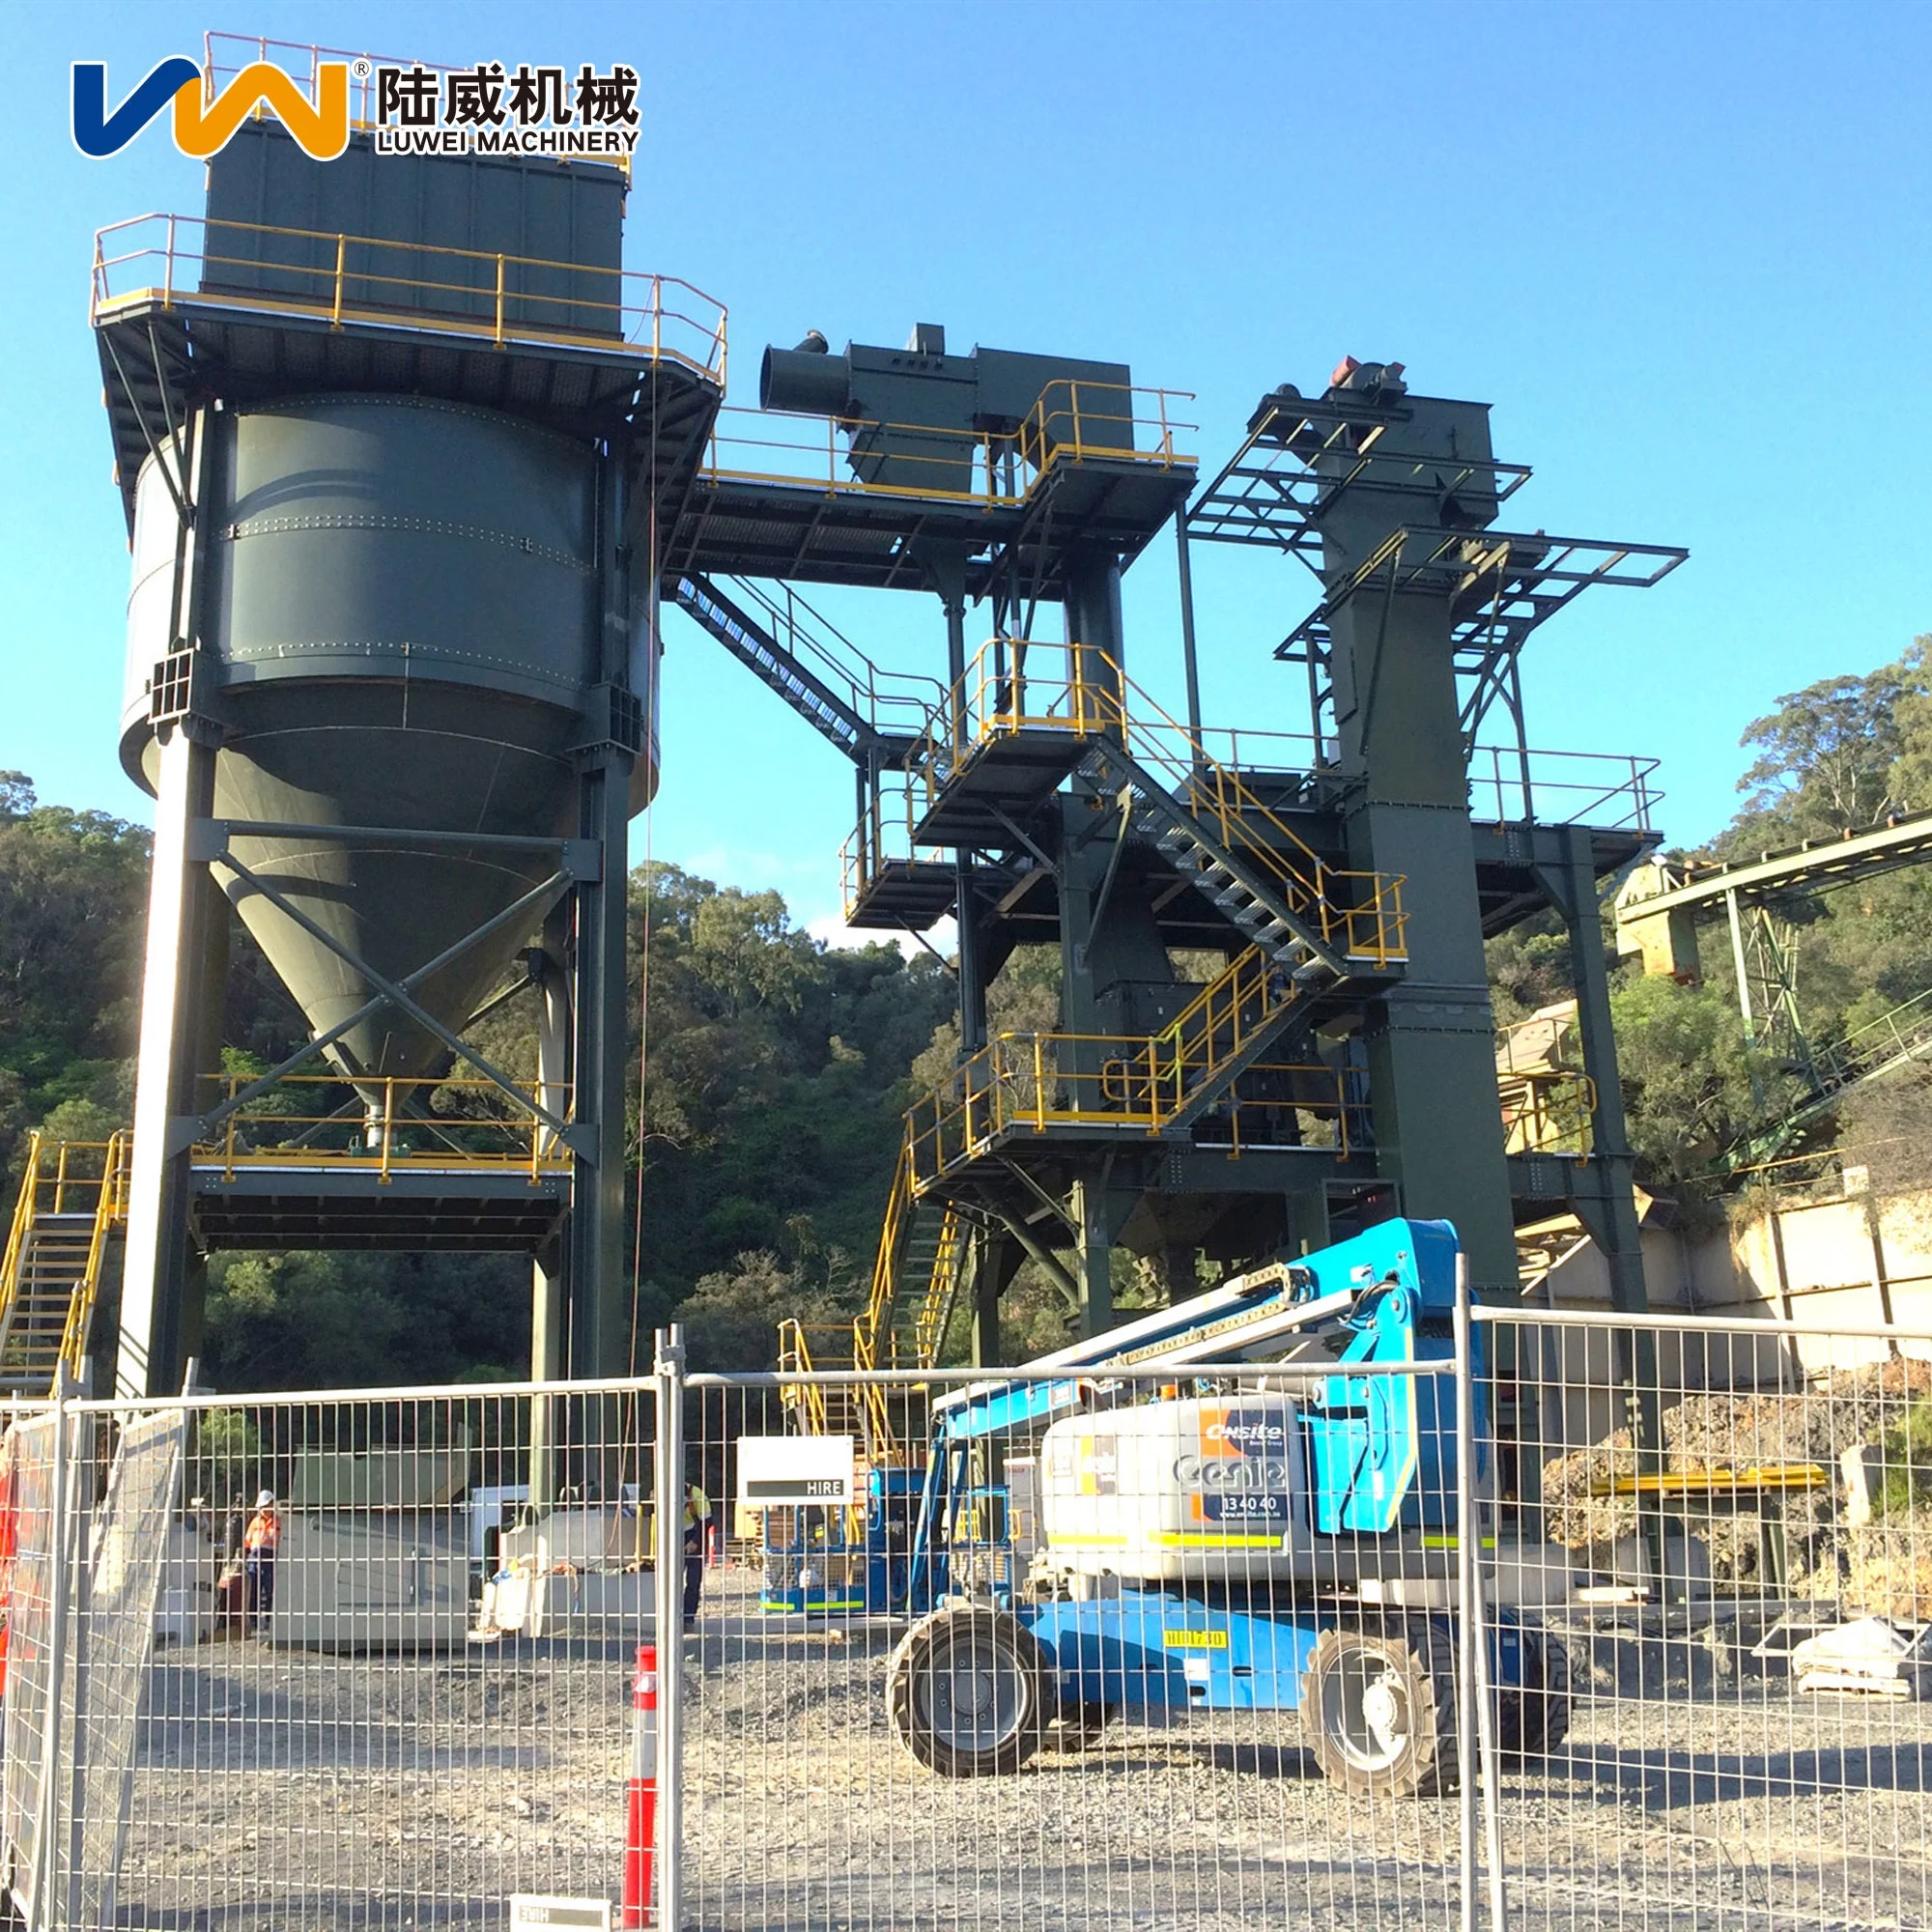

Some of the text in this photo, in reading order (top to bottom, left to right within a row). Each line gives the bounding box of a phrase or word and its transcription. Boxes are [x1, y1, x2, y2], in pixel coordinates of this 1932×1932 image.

[1173, 1455, 1286, 1488] Genie
[807, 1481, 840, 1495] HIRE
[1224, 1497, 1237, 1510] 13
[519, 1906, 550, 1923] HIRE
